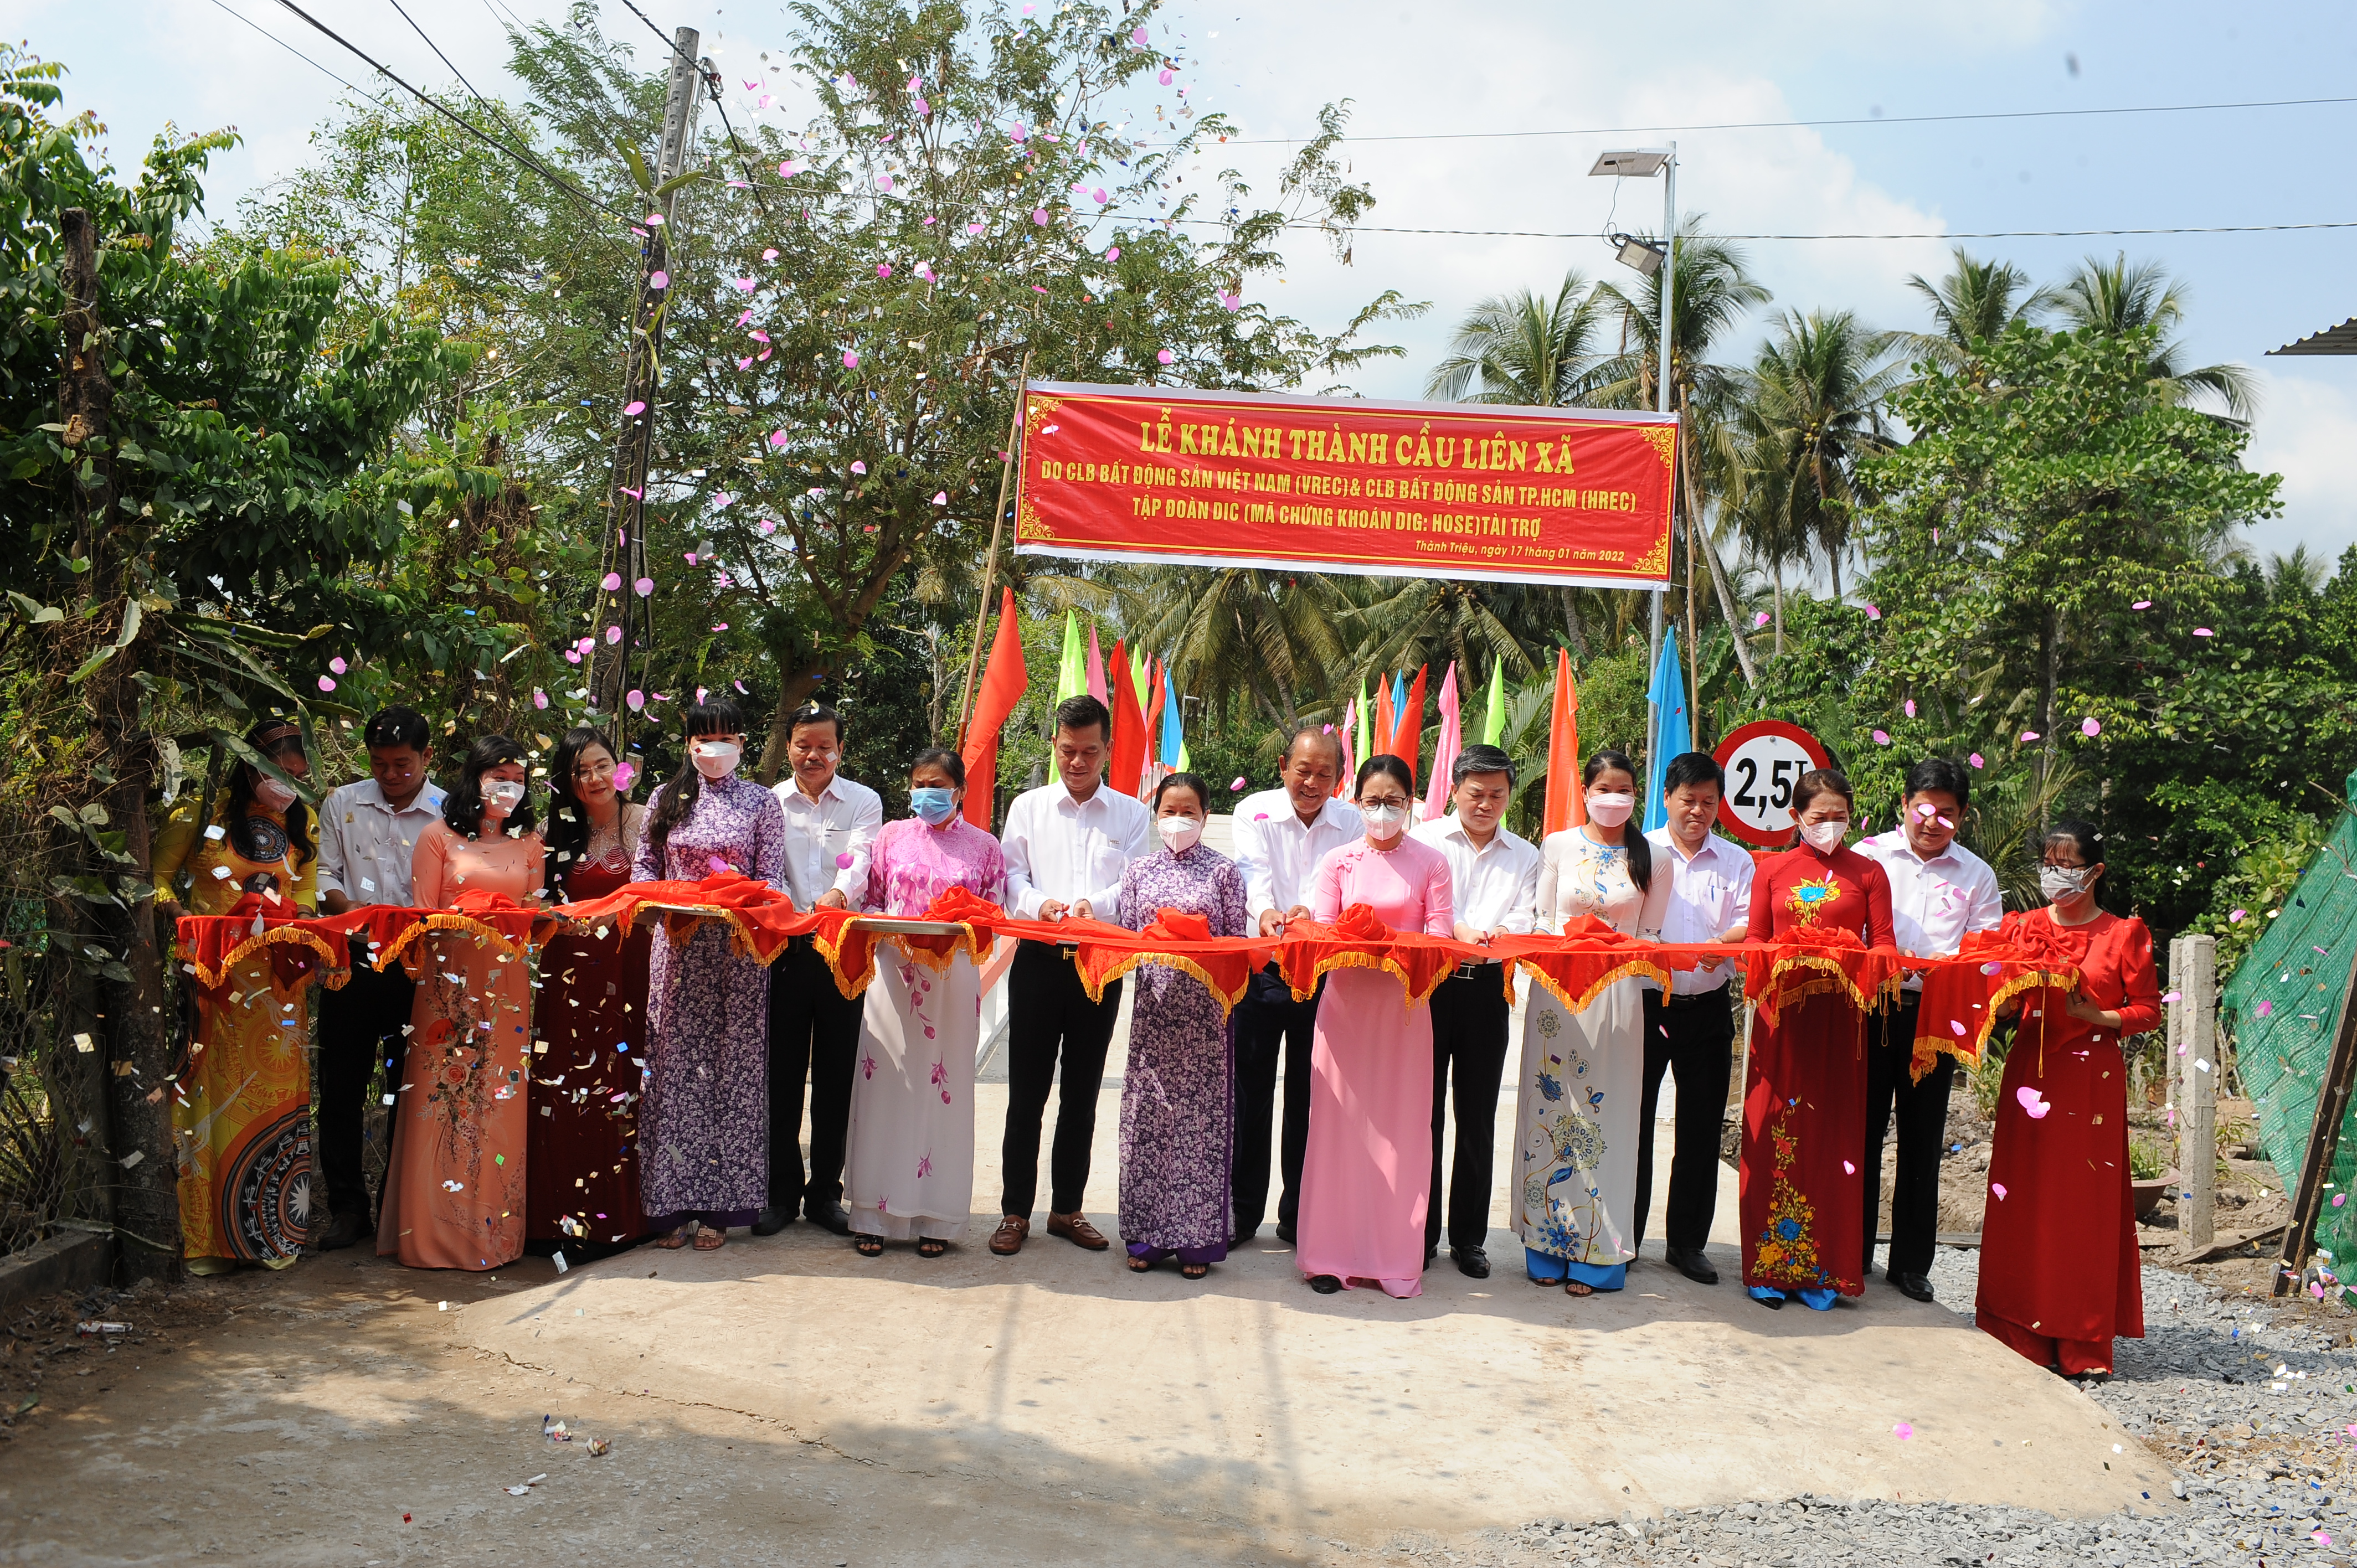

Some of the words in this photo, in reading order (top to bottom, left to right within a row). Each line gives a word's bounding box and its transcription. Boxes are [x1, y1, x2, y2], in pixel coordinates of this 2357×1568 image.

[1140, 407, 1172, 453] LỄ
[1180, 417, 1282, 458] KHÁNH
[1289, 423, 1388, 464] THÀNH
[1396, 421, 1455, 467] CẦU
[1462, 431, 1528, 471] LIÊN
[1534, 435, 1574, 474] XÃ
[1042, 461, 1062, 479] DO
[1067, 462, 1095, 481] CLB
[1100, 459, 1129, 483] BẤT
[1133, 463, 1176, 489] ĐỘNG
[1181, 463, 1212, 488] SẢN
[1217, 468, 1250, 493] VIỆT
[1254, 473, 1290, 492] NAM
[1366, 479, 1394, 498] CLB
[1399, 475, 1429, 499] BẤT
[1433, 479, 1477, 505] ĐỘNG
[1482, 479, 1514, 504] SẢN
[1519, 487, 1576, 508] TP.HCM
[1582, 491, 1635, 513] (HREC)
[1133, 494, 1161, 520] TẬP
[1166, 497, 1208, 519] ĐOÀN
[1213, 502, 1239, 521] DIC
[1244, 502, 1274, 524] (MÃ
[1280, 503, 1333, 526] CHỨNG
[1337, 507, 1391, 529] KHOÁN
[1396, 512, 1427, 531] DIG:
[1511, 518, 1541, 541] TRỢ
[1416, 540, 1447, 553] Thành
[1450, 542, 1478, 556] Triệu,
[1481, 544, 1507, 557] ngày
[1511, 545, 1522, 556] 17
[1525, 546, 1555, 560] tháng
[1558, 548, 1571, 559] 01
[1573, 549, 1596, 560] năm
[1599, 550, 1624, 561] 2022
